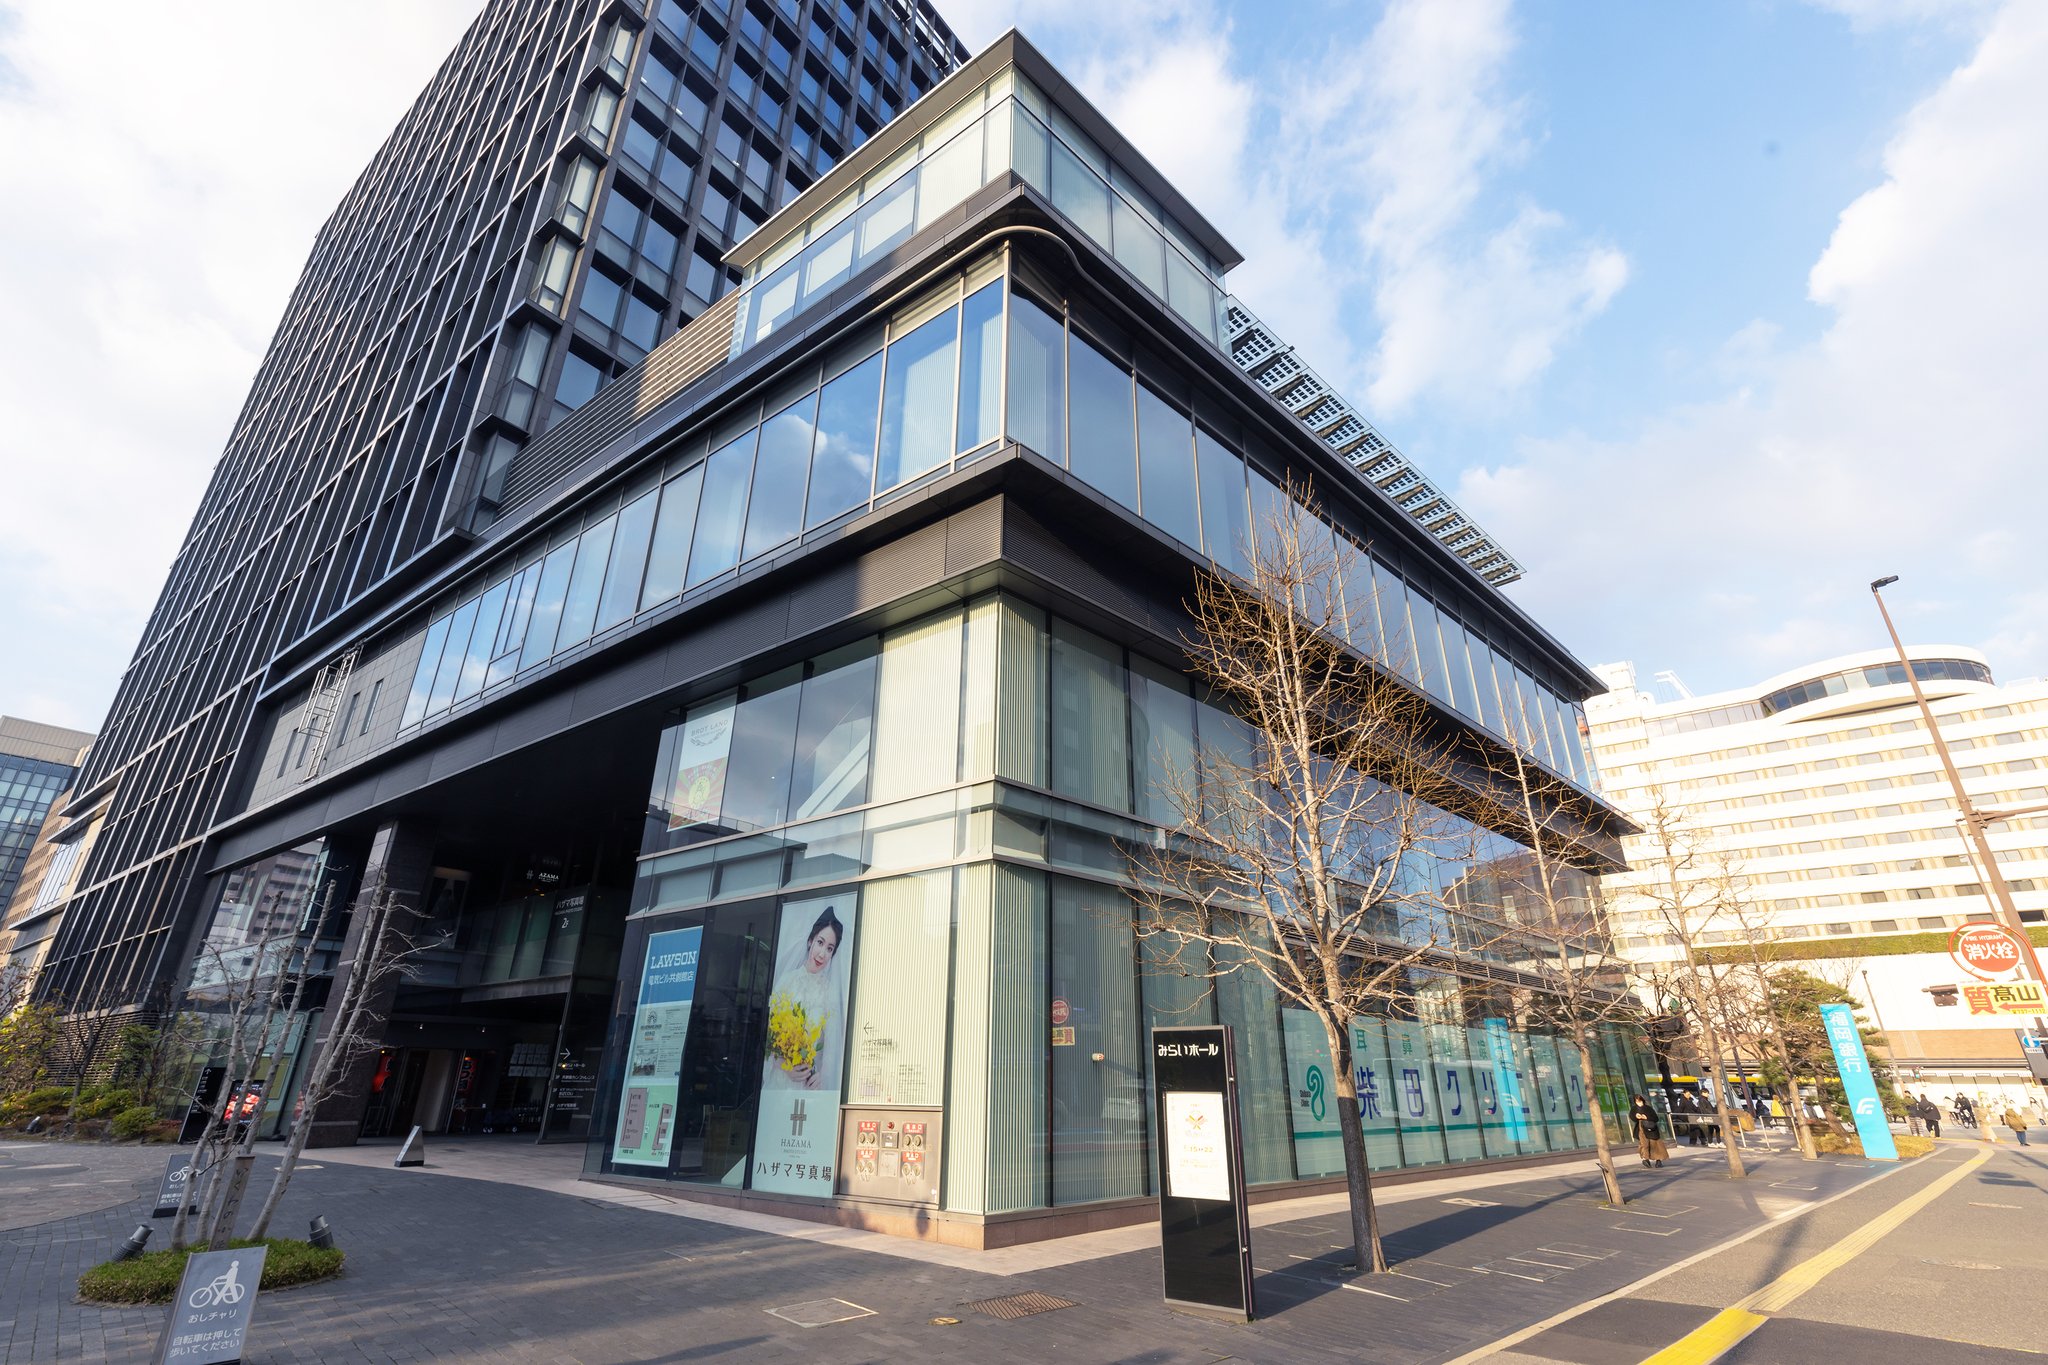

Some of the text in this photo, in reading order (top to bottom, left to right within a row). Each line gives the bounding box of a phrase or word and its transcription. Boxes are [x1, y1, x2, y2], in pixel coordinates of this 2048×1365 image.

[710, 719, 728, 730] LAND
[650, 950, 698, 970] LAWSON
[1964, 941, 2017, 961] 消火栓
[1963, 985, 1998, 1015] 質
[1158, 1043, 1219, 1057] みらいホール
[1828, 1010, 1863, 1073] 福岡銀行
[780, 1138, 812, 1149] HAZAMA
[756, 1162, 832, 1182] ハザマ写真場
[188, 1308, 237, 1323] おしチャリ
[173, 1327, 242, 1347] 自転車は押して
[169, 1339, 240, 1358] 歩いてください
